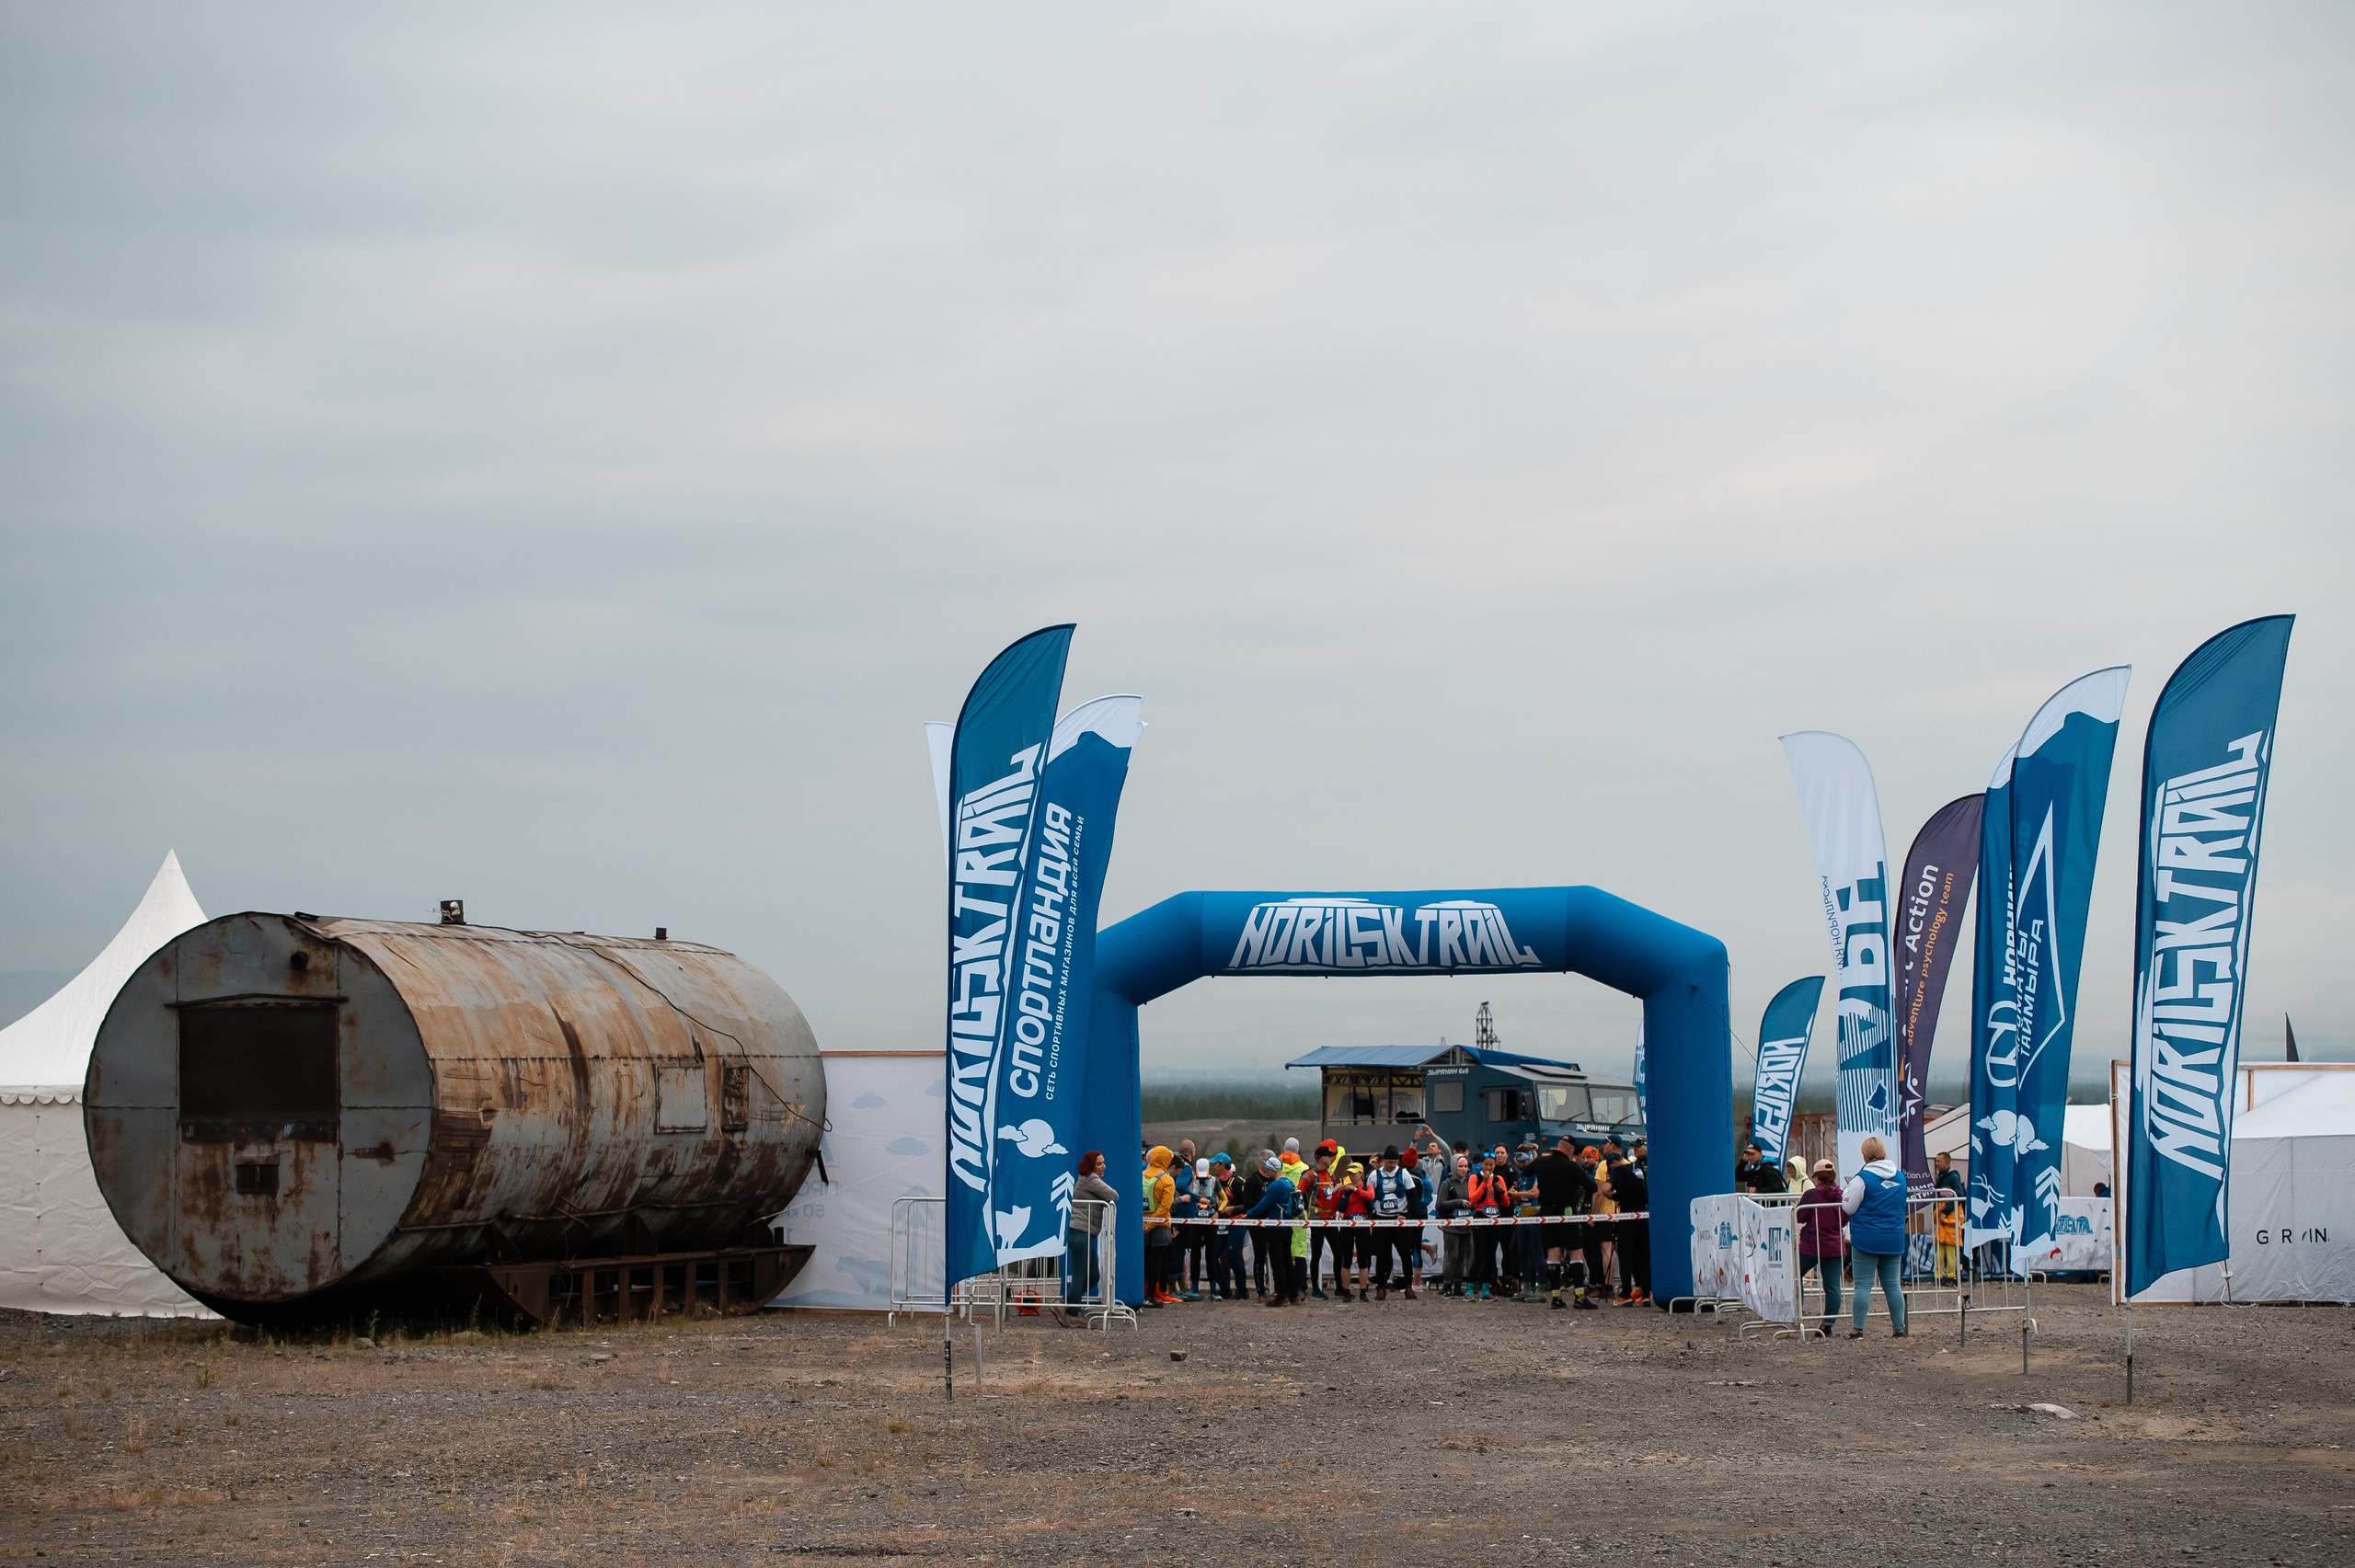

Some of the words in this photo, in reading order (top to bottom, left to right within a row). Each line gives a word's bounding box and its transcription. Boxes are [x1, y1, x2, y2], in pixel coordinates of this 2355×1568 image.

[955, 741, 1042, 917] TRAIL
[1074, 815, 1085, 855] СЕМЬИ
[2156, 730, 2265, 904] TRAIL
[1069, 890, 1078, 916] ДЛЯ
[1229, 907, 1419, 967] NORILSK
[1415, 907, 1542, 967] TRAIL
[1905, 864, 1939, 953] Action
[1060, 917, 1076, 986] МАГАЗИНОВ
[1907, 980, 1924, 1046] adventure
[1921, 907, 1947, 978] psychology
[1940, 872, 1954, 905] team
[2021, 920, 2044, 1057] ТАЙМЫРА
[1050, 988, 1067, 1069] СПОРТИВНЫХ
[2148, 905, 2238, 1180] NORILSK
[1045, 1070, 1057, 1101] СЕТЬ
[1576, 1123, 1610, 1132] ЗЫРЯНИН
